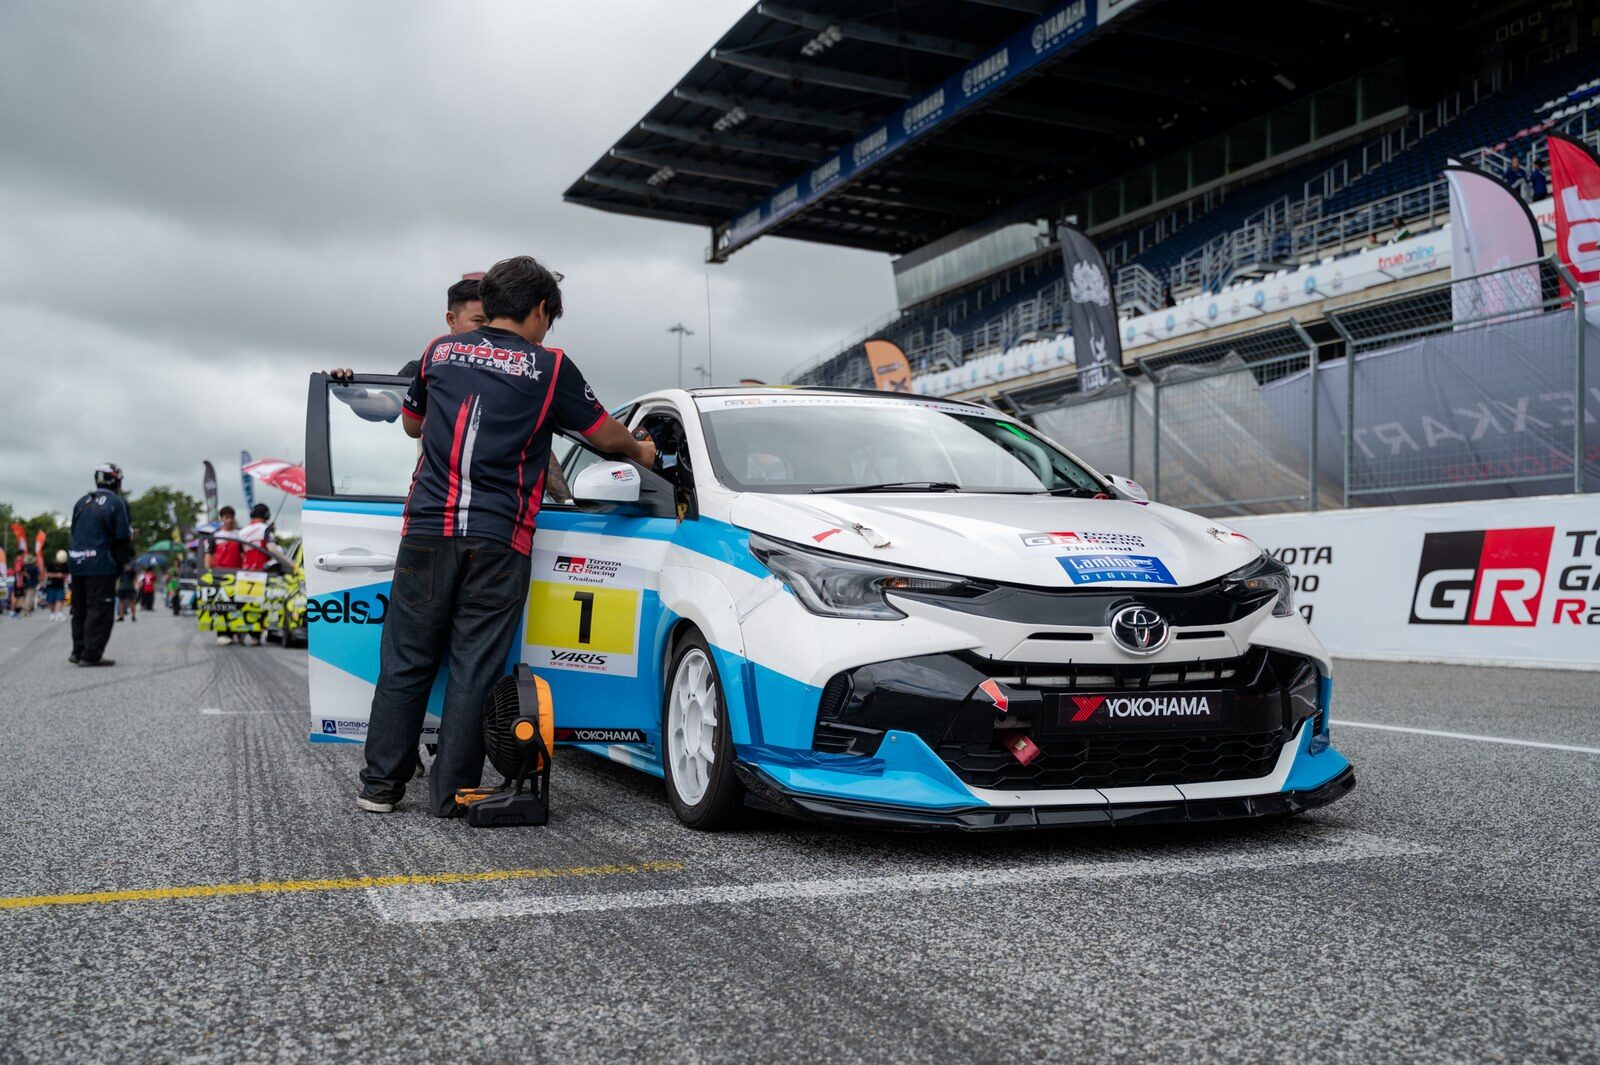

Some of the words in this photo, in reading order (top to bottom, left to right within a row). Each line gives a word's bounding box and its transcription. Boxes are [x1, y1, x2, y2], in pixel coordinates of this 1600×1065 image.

[1022, 534, 1081, 546] GR
[1565, 530, 1600, 557] T
[553, 560, 585, 574] GR
[586, 564, 618, 572] GAZOO
[588, 558, 622, 567] TOYOTA
[568, 575, 604, 584] Thailand
[585, 569, 616, 578] Racing
[1081, 572, 1164, 582] DIGITAL
[247, 582, 255, 595] 7
[1412, 562, 1544, 623] GR
[573, 591, 594, 645] 1
[1105, 696, 1211, 718] YOKOHAMA
[575, 730, 641, 741] YOKOHAMA
